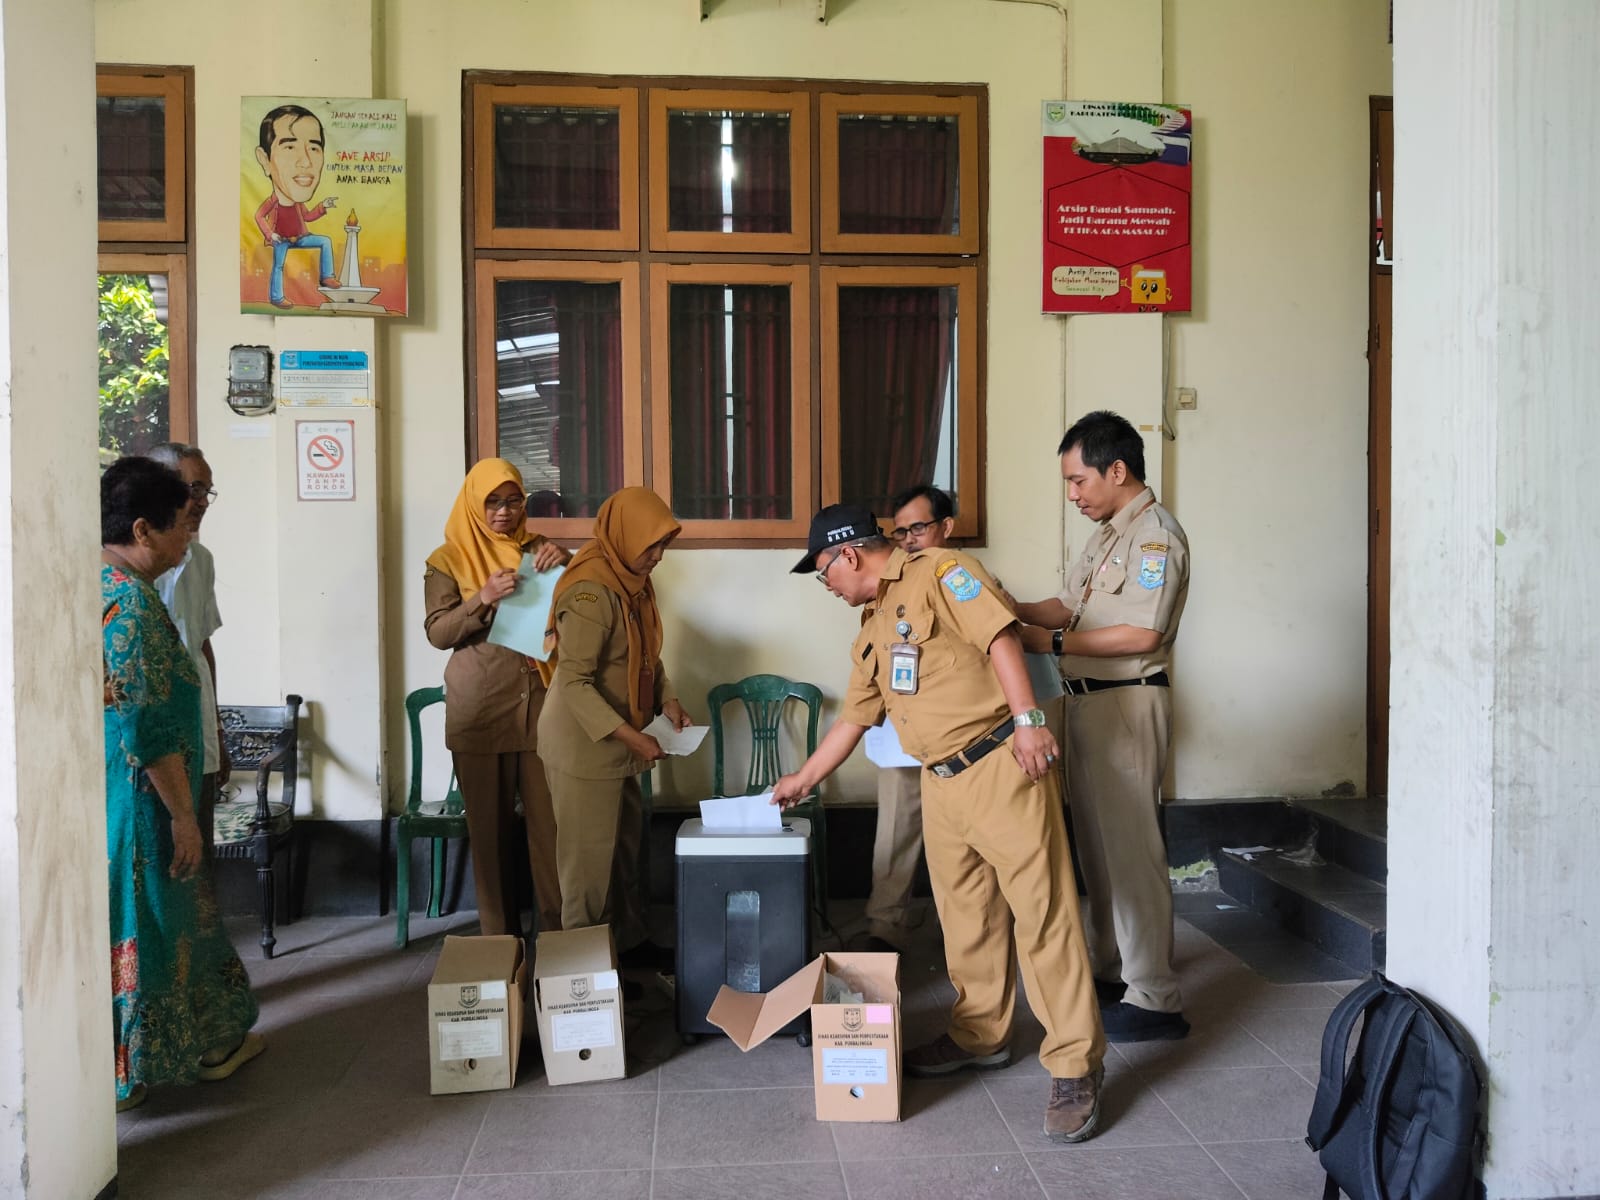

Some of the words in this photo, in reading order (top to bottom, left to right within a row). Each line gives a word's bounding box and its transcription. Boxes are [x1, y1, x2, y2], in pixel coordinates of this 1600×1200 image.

[336, 151, 359, 161] SAVE
[363, 151, 391, 162] ARSIP
[327, 163, 350, 172] UNTUK
[354, 163, 374, 173] MASA
[378, 164, 403, 174] DEPAN
[336, 175, 358, 184] ANAK
[361, 175, 391, 184] BANGSA
[1057, 205, 1087, 214] Arsip
[1090, 205, 1121, 214] Bagai
[1058, 215, 1084, 224] Jadi
[1086, 216, 1128, 225] Barang
[1130, 217, 1171, 225] Mewah
[1100, 227, 1120, 235] ADA
[828, 529, 855, 542] BARU
